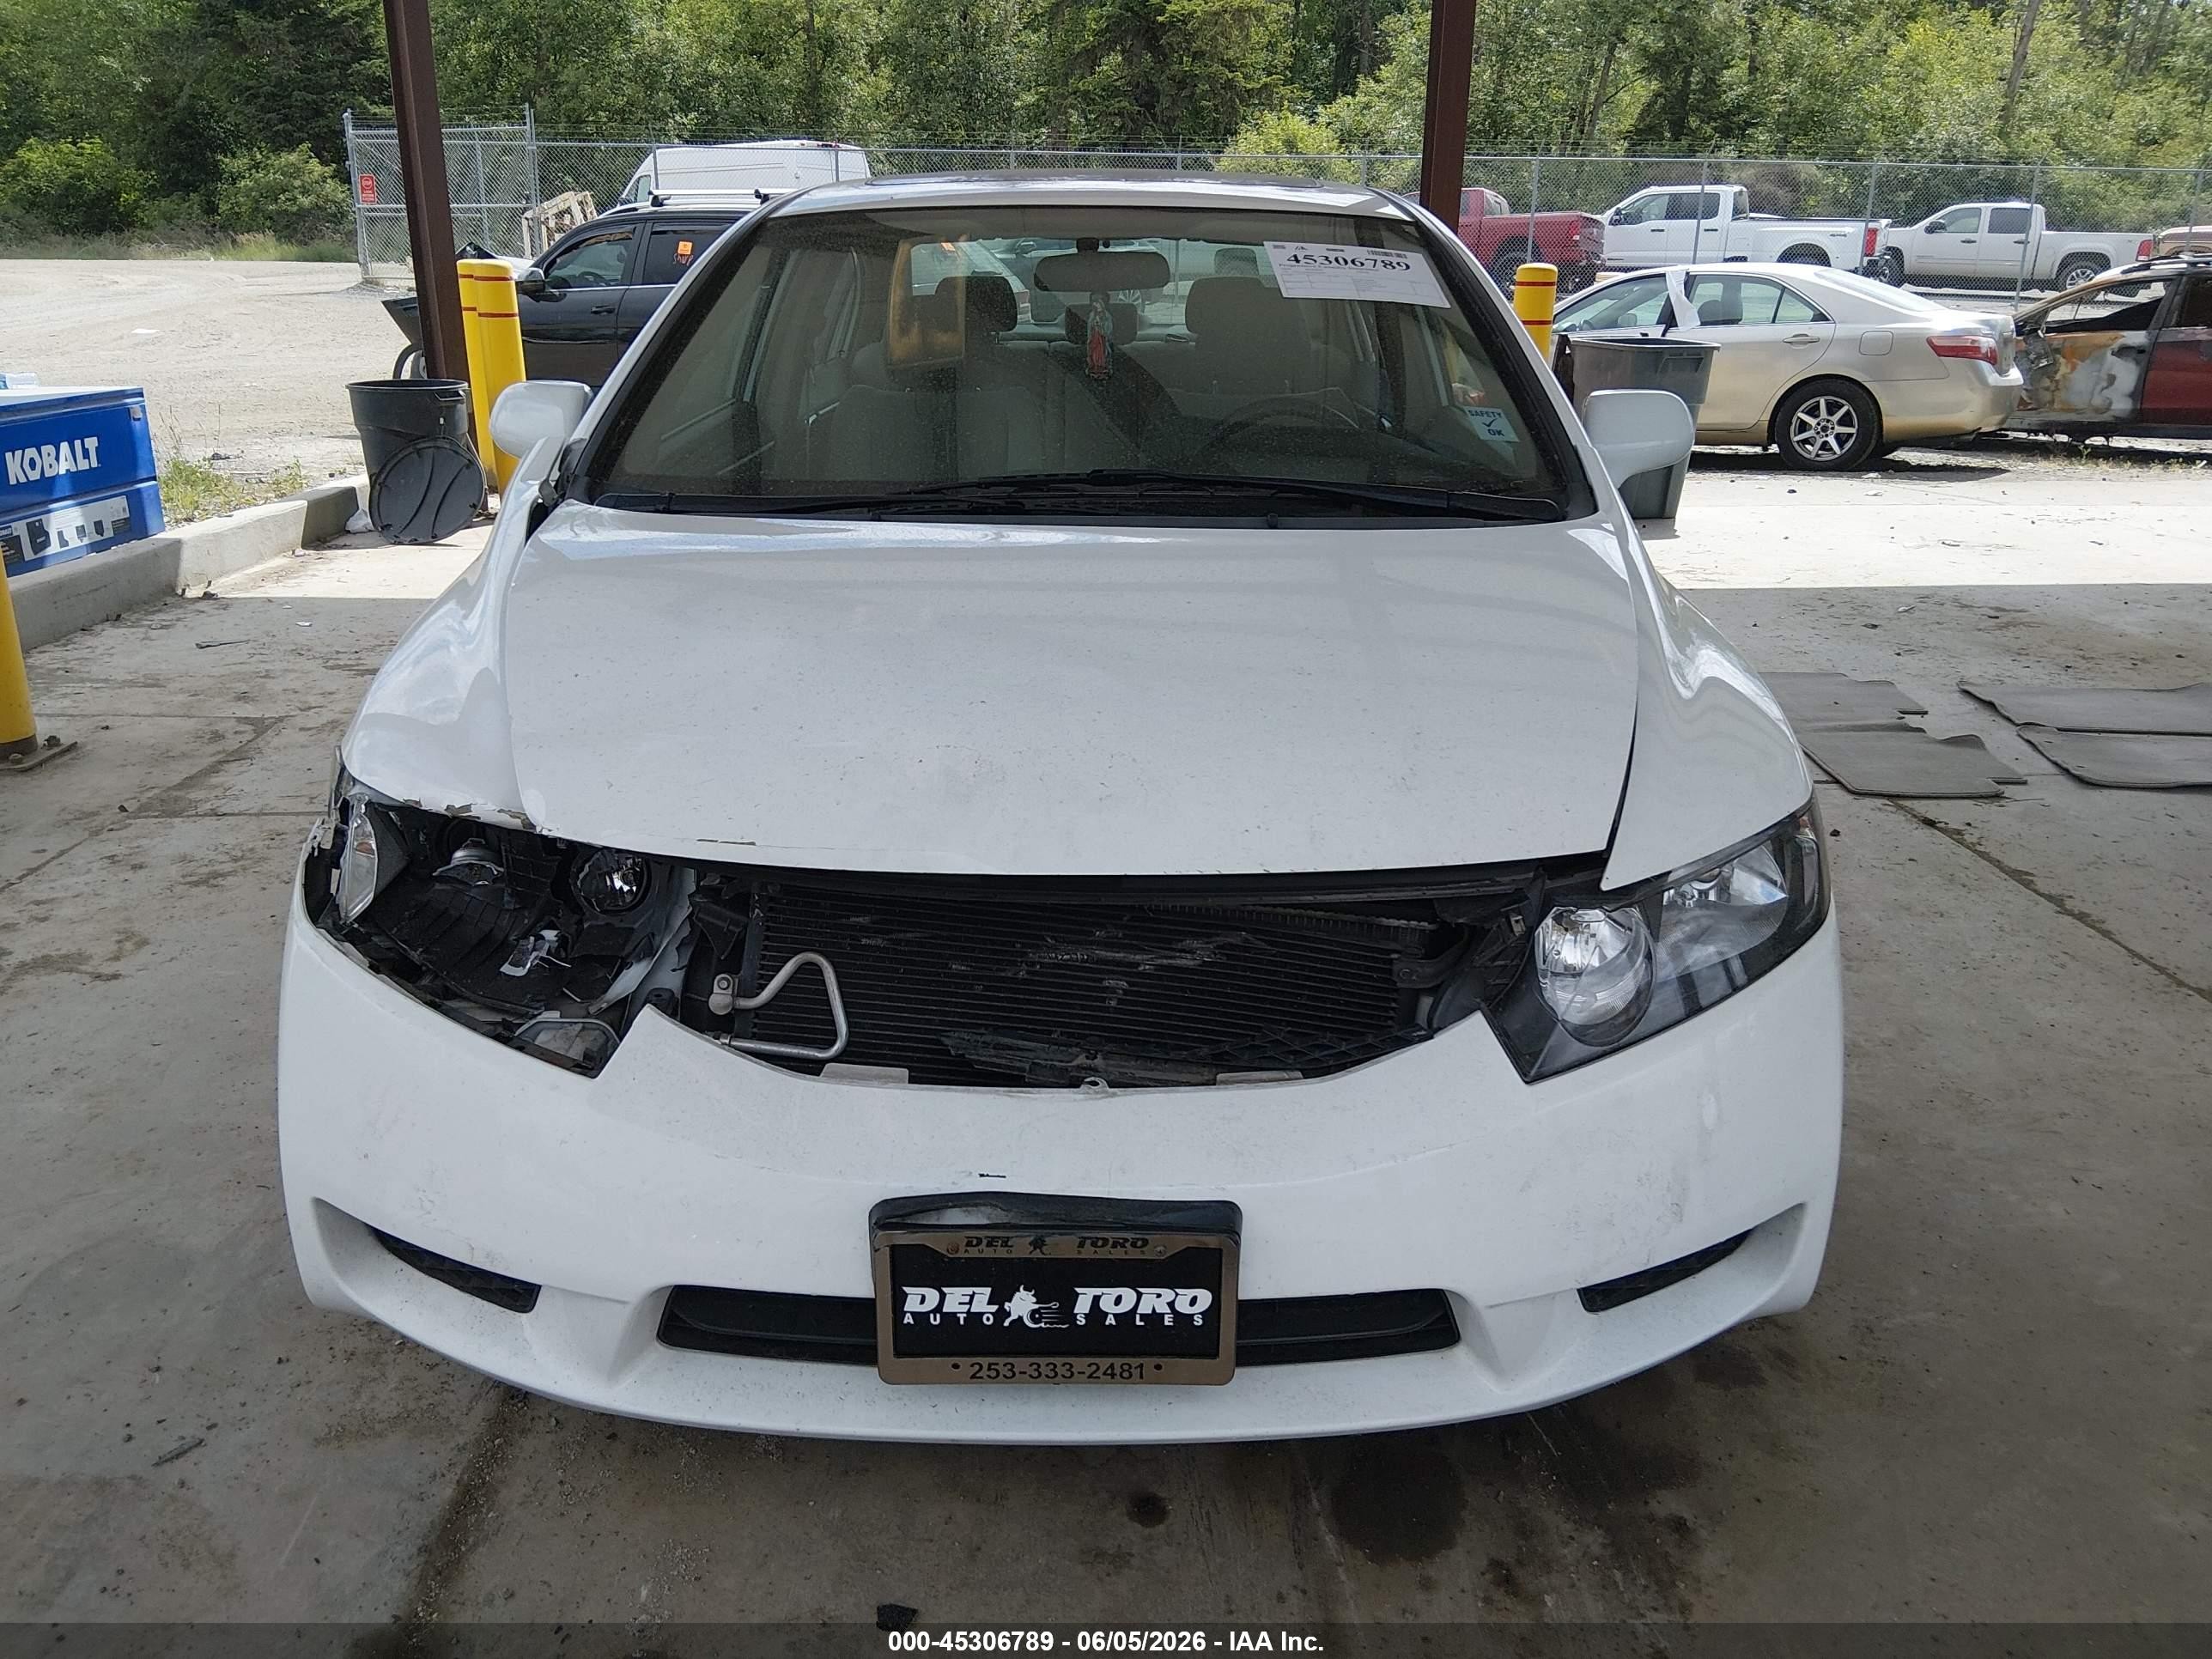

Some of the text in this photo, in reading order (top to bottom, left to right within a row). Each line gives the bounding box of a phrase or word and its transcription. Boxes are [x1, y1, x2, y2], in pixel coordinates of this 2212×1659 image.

[1286, 253, 1411, 271] 45306789
[1468, 410, 1502, 418] SAFETY
[1487, 428, 1505, 437] OK
[5, 436, 99, 485] KOBALT
[964, 1236, 1149, 1249] DEL TORO
[902, 1287, 1212, 1314] DEL TORO
[903, 1314, 1203, 1326] AUTO SALES
[969, 1362, 1145, 1380] 253-333-2481
